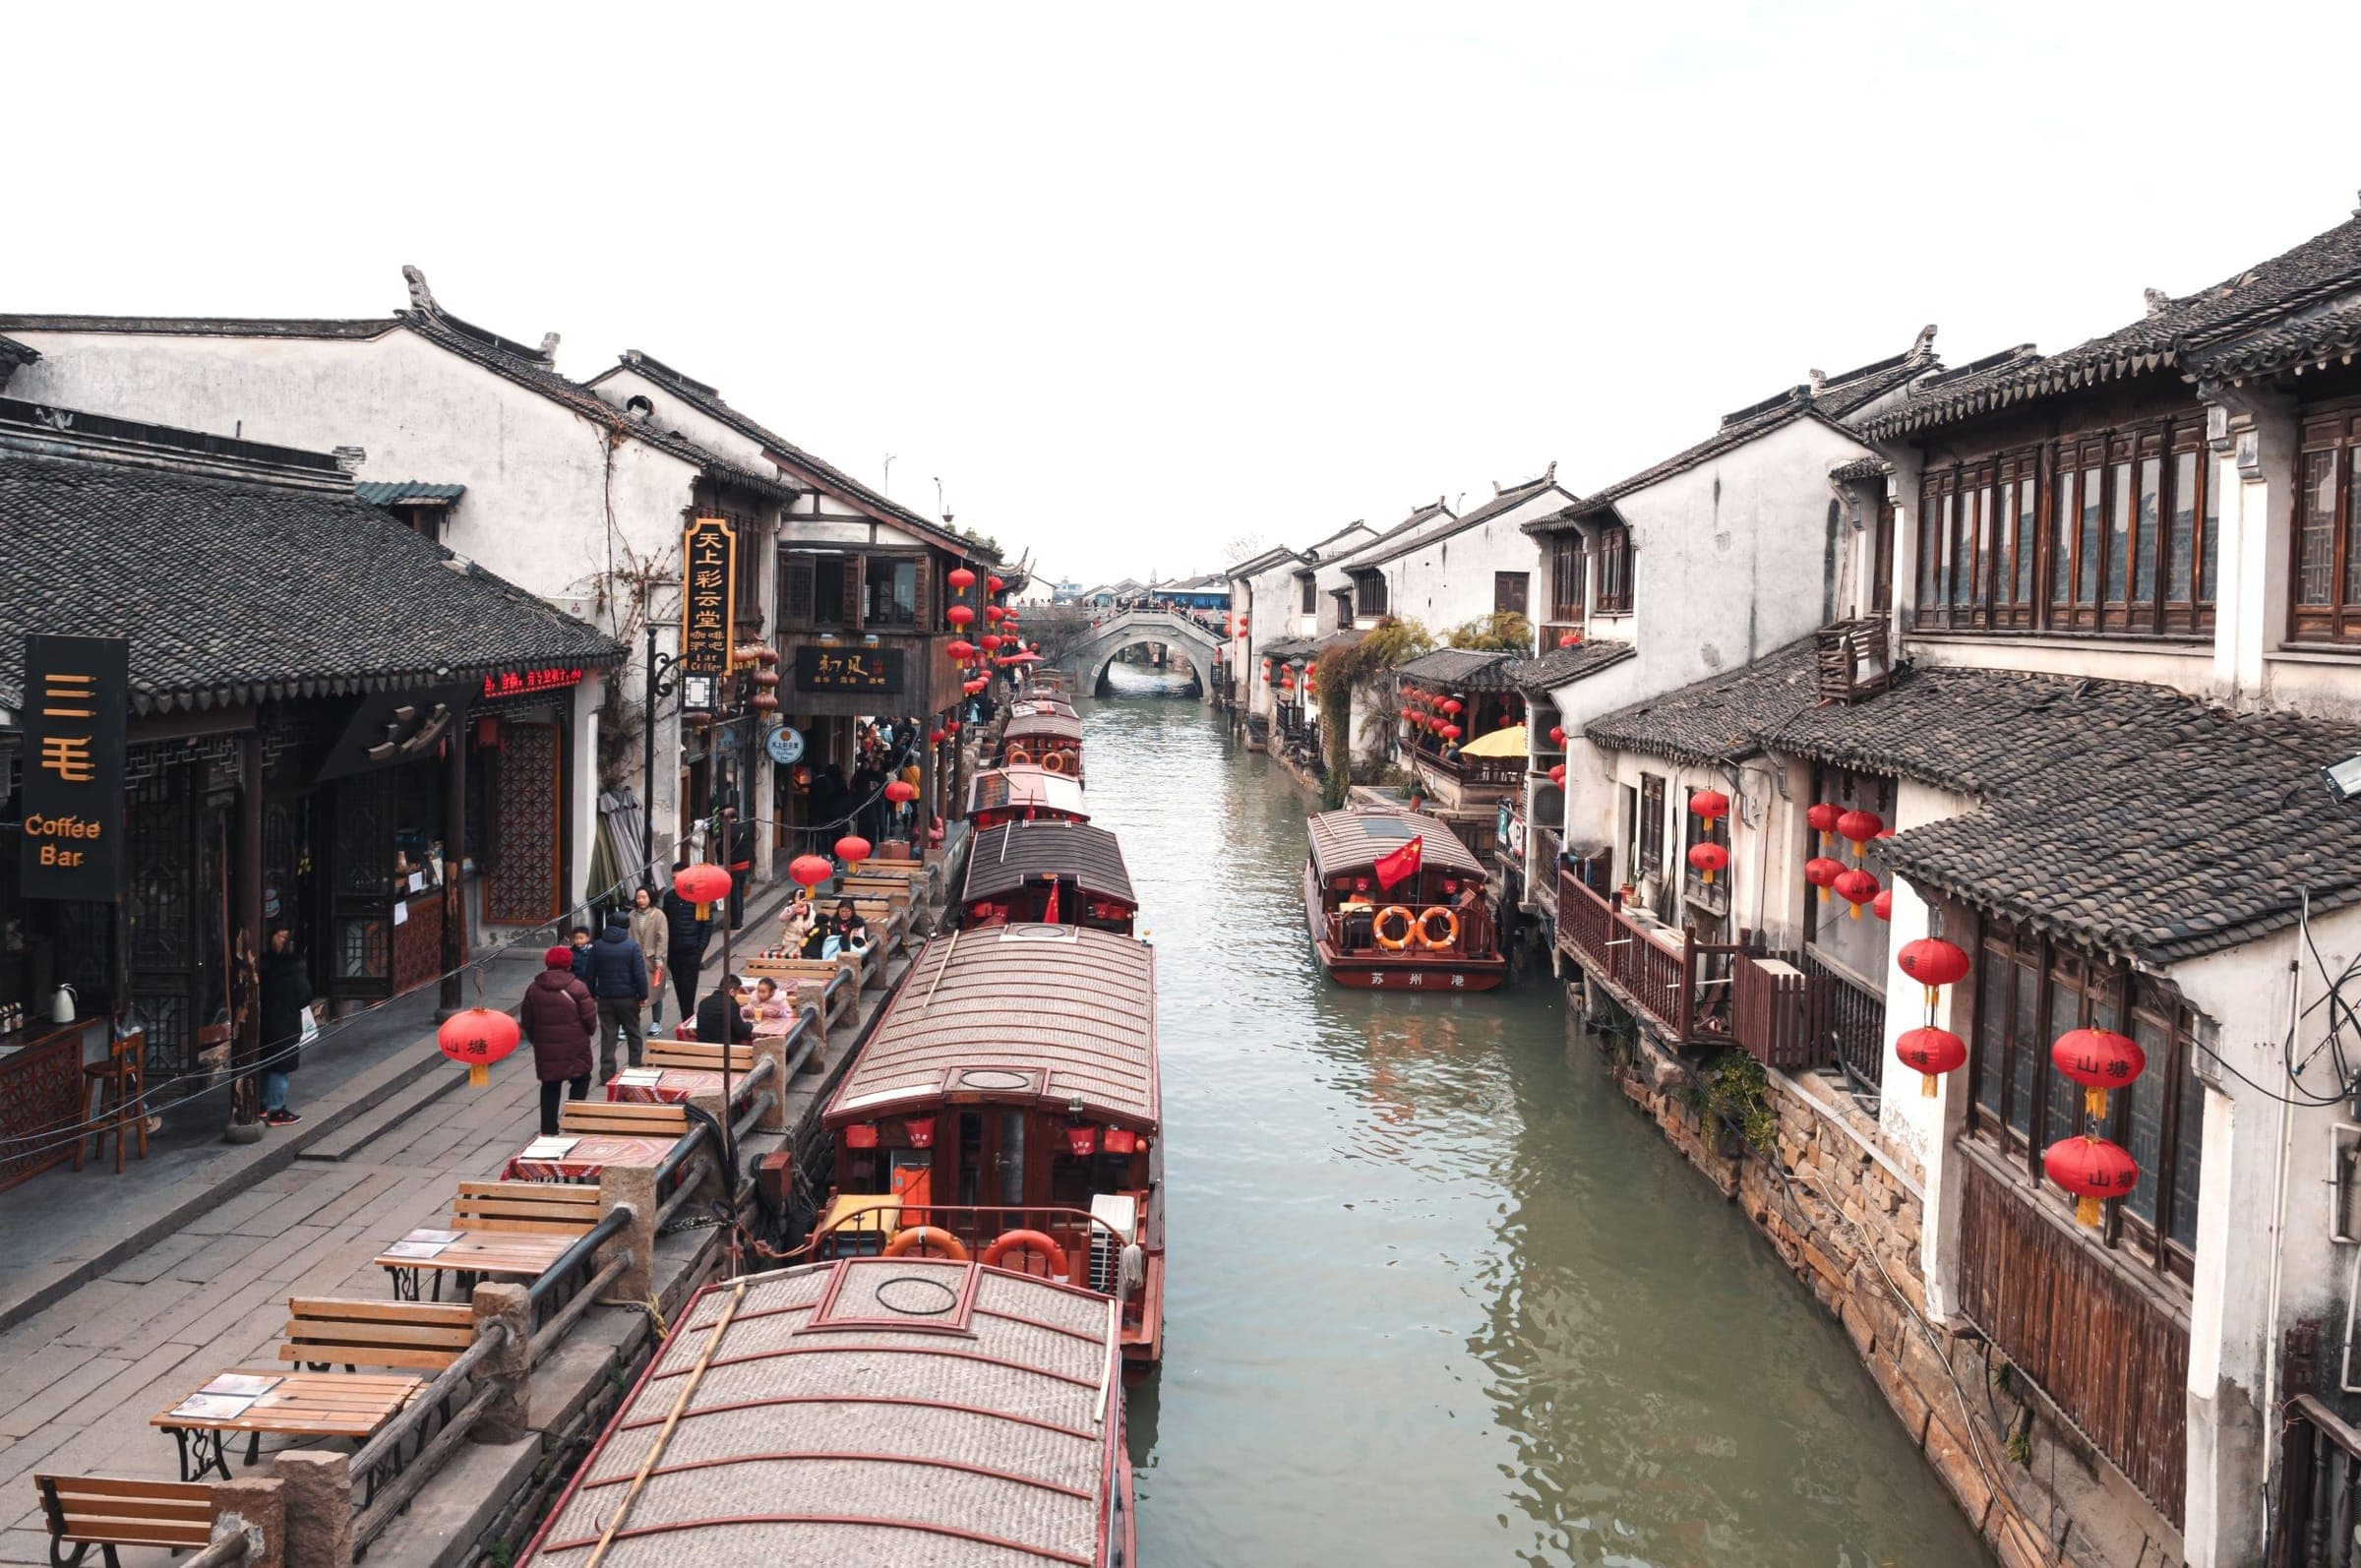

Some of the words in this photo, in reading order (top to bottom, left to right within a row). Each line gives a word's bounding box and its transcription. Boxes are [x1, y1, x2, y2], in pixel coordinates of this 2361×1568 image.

[693, 532, 724, 629] 天上彩云堂
[41, 674, 96, 781] 三毛
[25, 813, 101, 838] Coffee
[39, 843, 85, 867] Bar
[1371, 972, 1464, 987] 苏州港
[446, 1038, 488, 1055] 山塘
[2077, 1055, 2130, 1078] 山塘
[2089, 1169, 2135, 1187] 山塘
